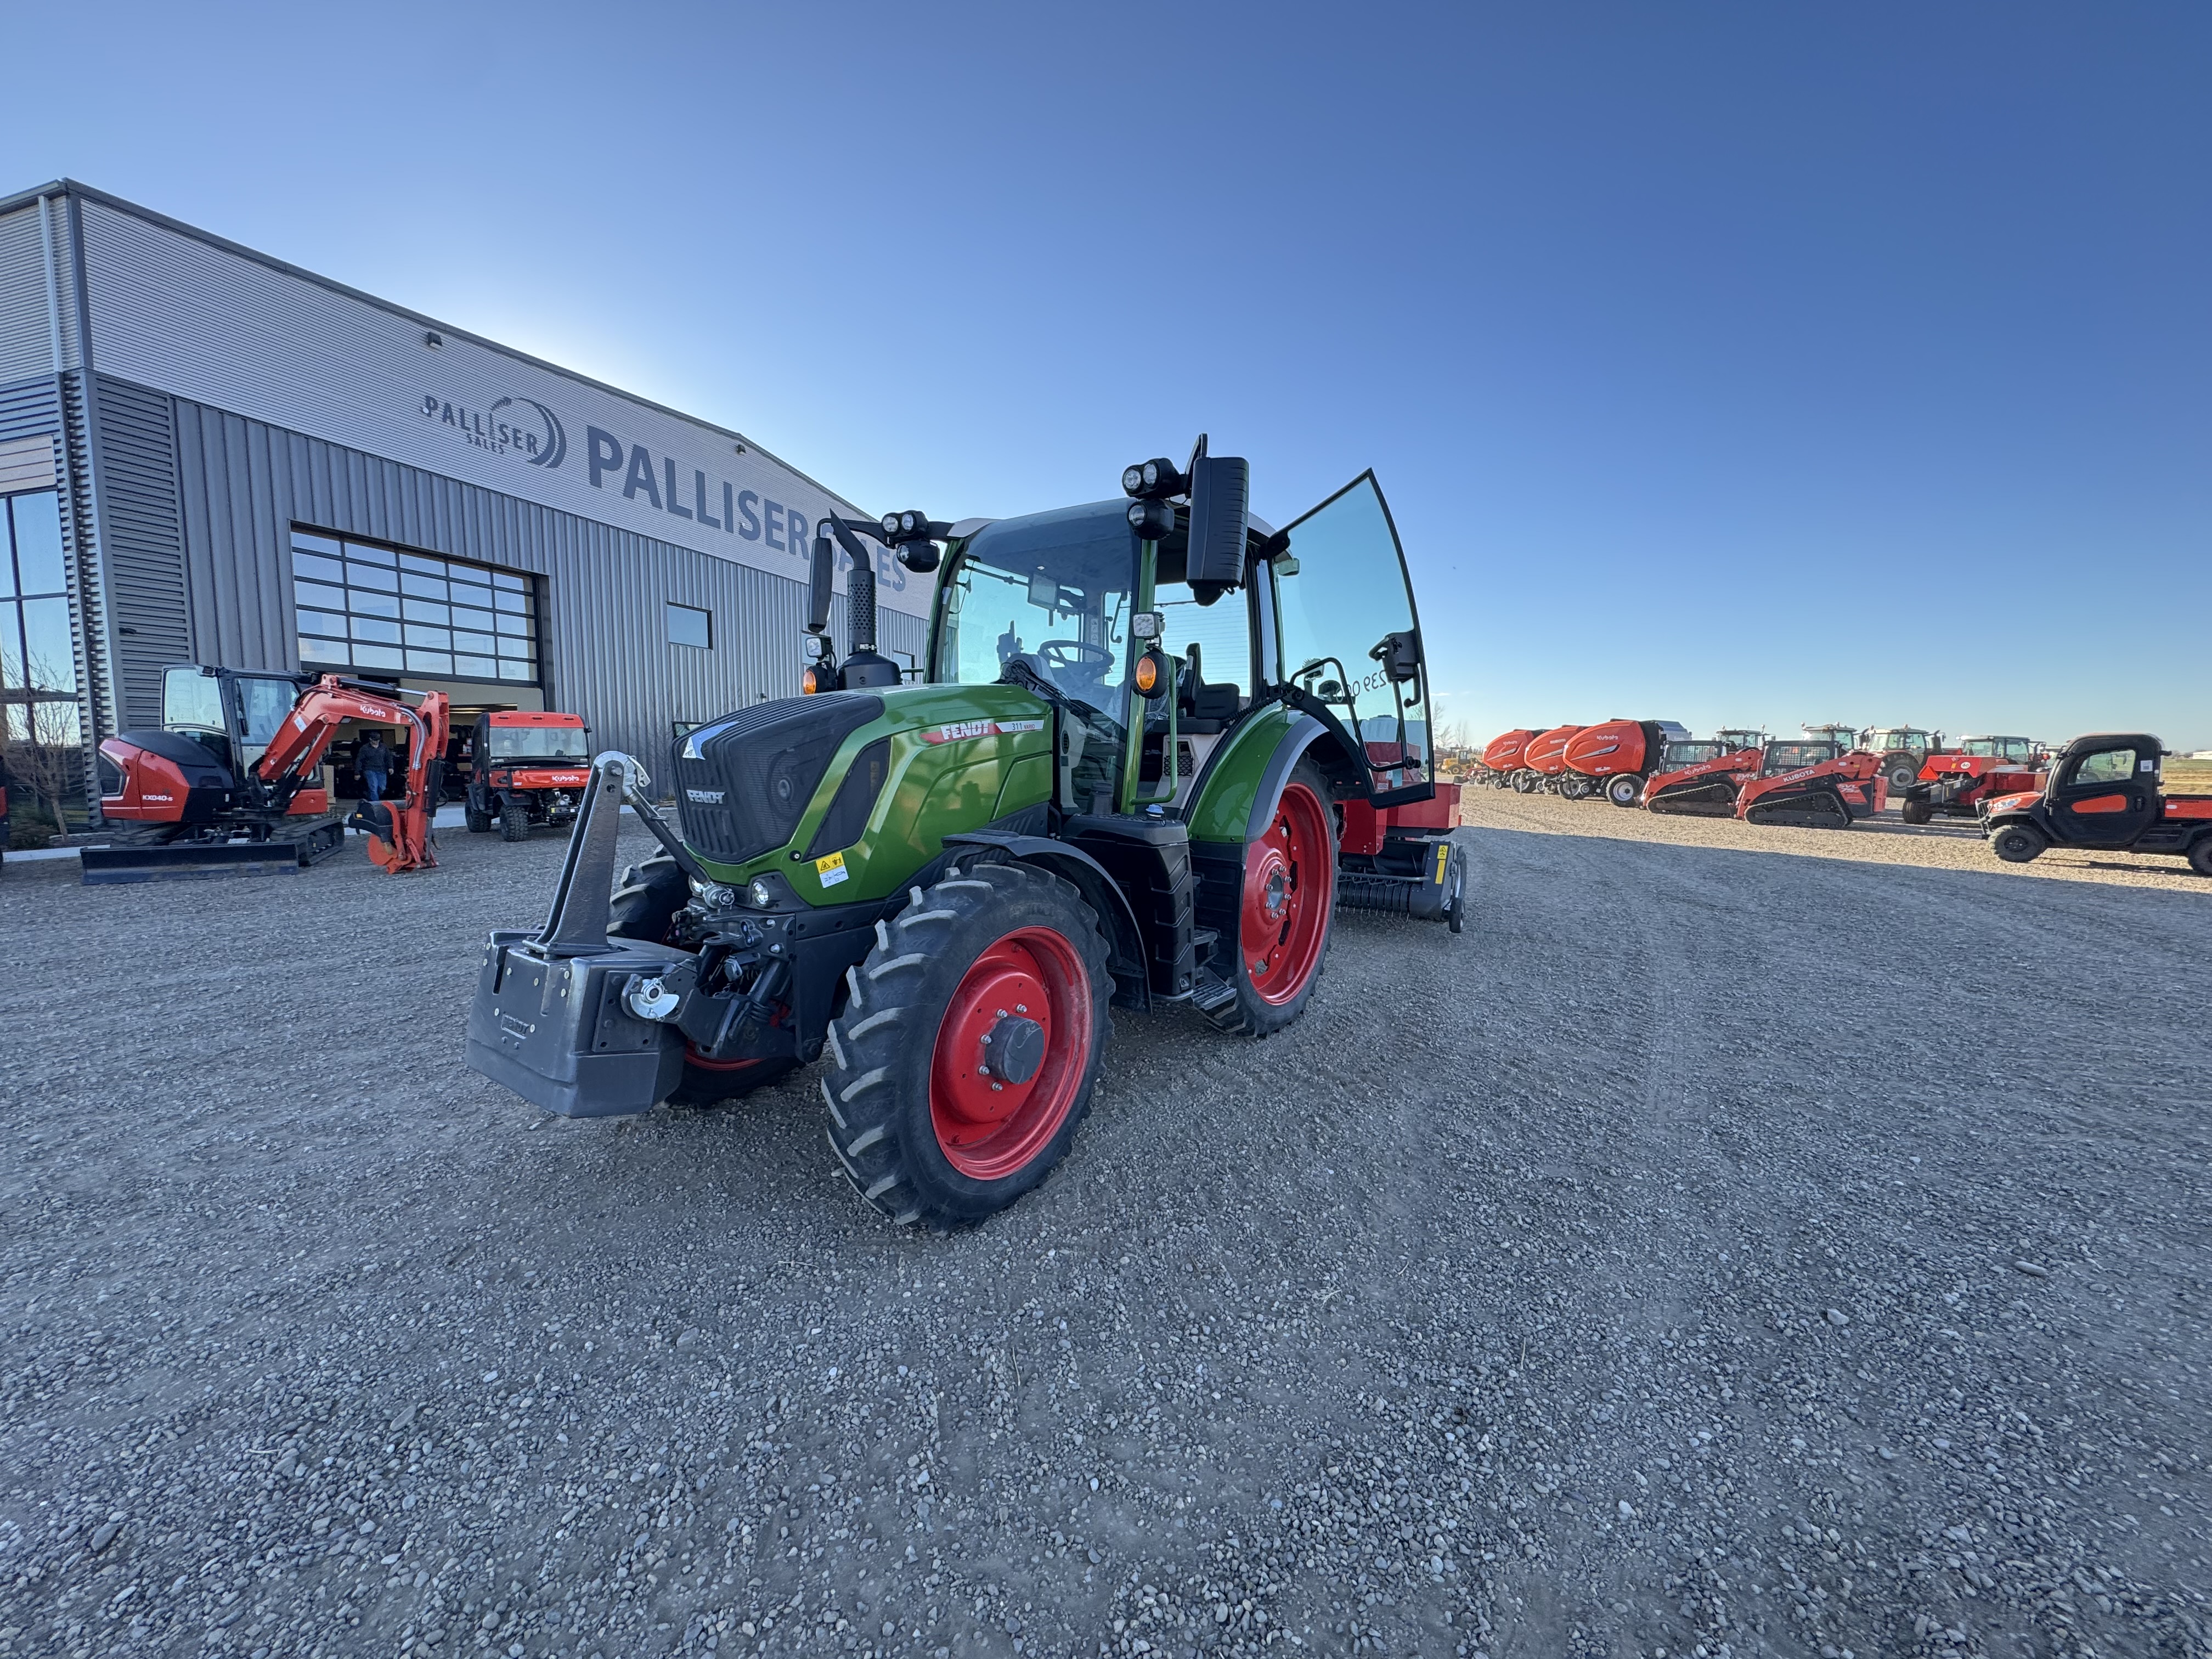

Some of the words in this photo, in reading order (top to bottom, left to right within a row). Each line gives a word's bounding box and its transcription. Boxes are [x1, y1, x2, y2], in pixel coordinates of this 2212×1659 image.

[424, 394, 538, 455] PALLISER
[466, 433, 504, 454] SALES
[587, 425, 809, 561] PALLISER
[821, 524, 906, 591] SES
[360, 704, 386, 718] Kubota
[940, 720, 991, 740] FENDT
[1012, 722, 1023, 730] 311
[1684, 764, 1711, 775] Kubota
[1783, 769, 1815, 783] KUBOTA
[686, 789, 725, 805] FENDT
